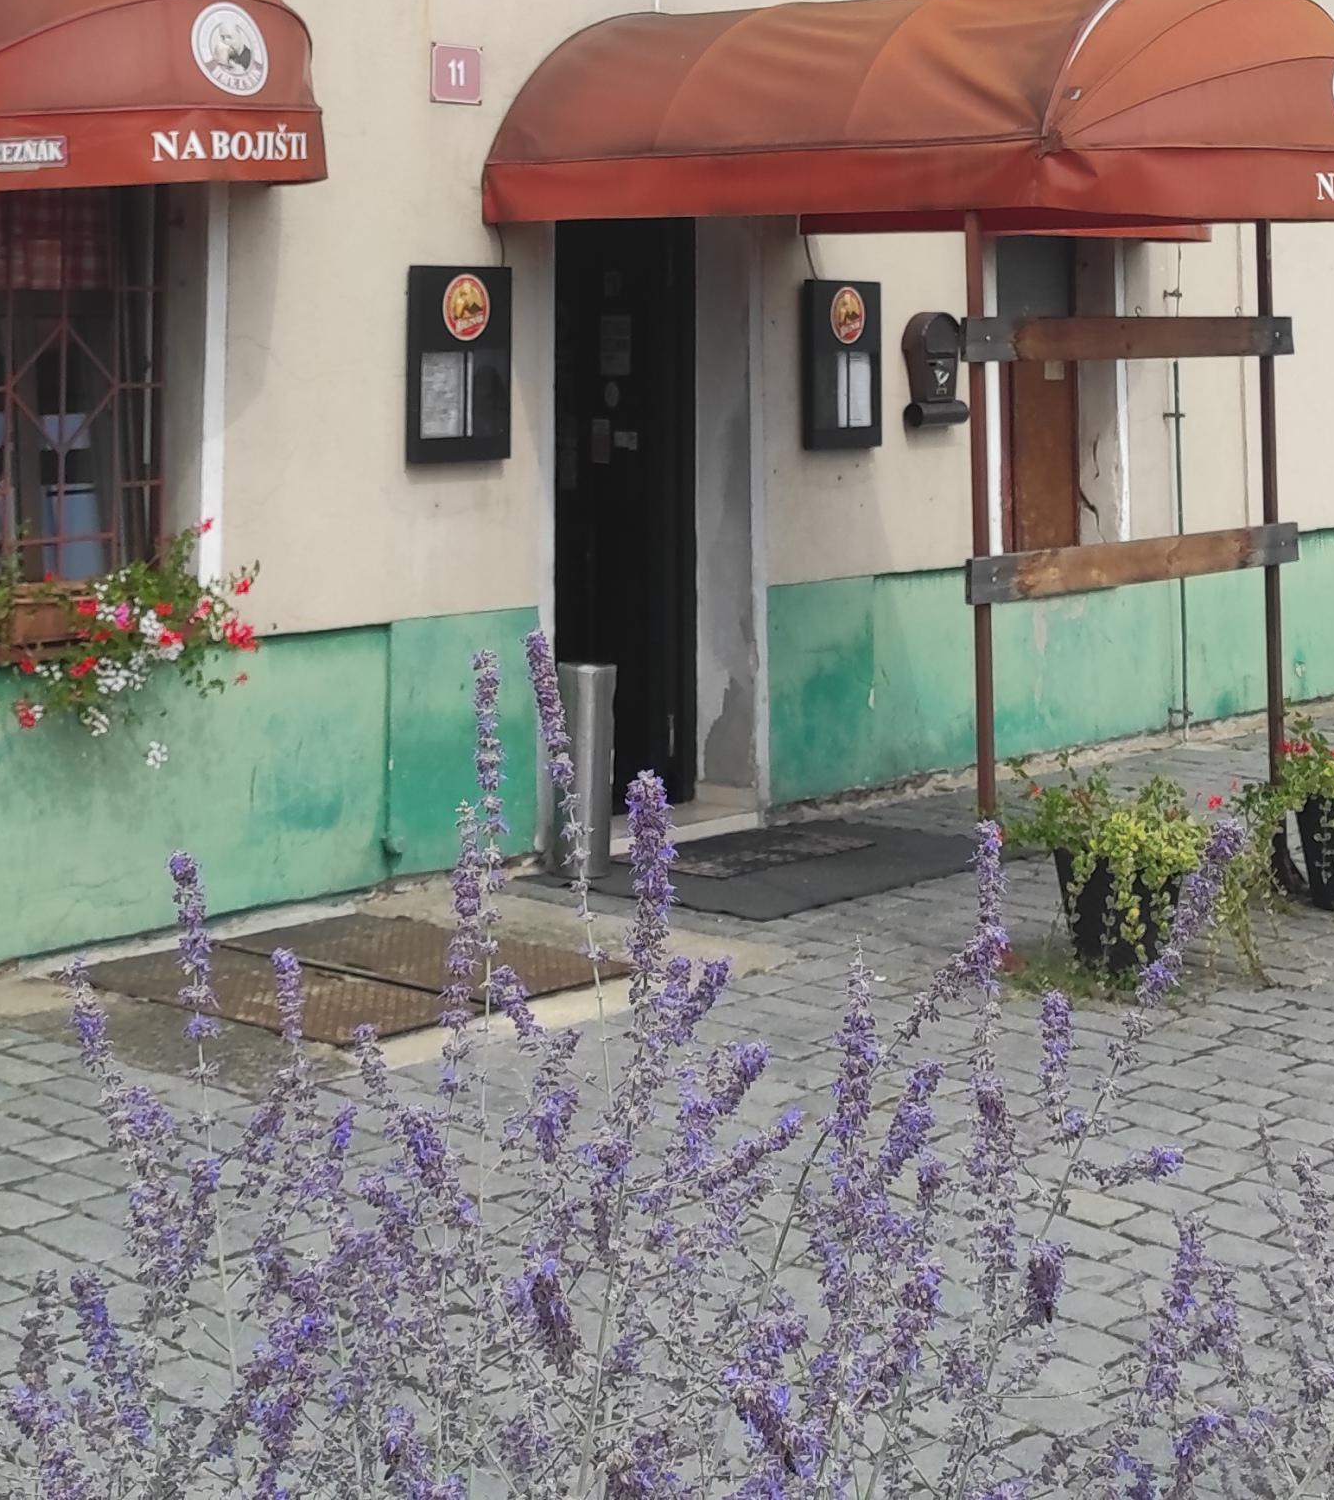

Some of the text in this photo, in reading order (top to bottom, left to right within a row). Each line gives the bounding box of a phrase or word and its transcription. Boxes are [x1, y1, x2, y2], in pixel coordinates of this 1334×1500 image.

[448, 58, 465, 87] 11
[151, 122, 308, 162] NA BOJIŠTI
